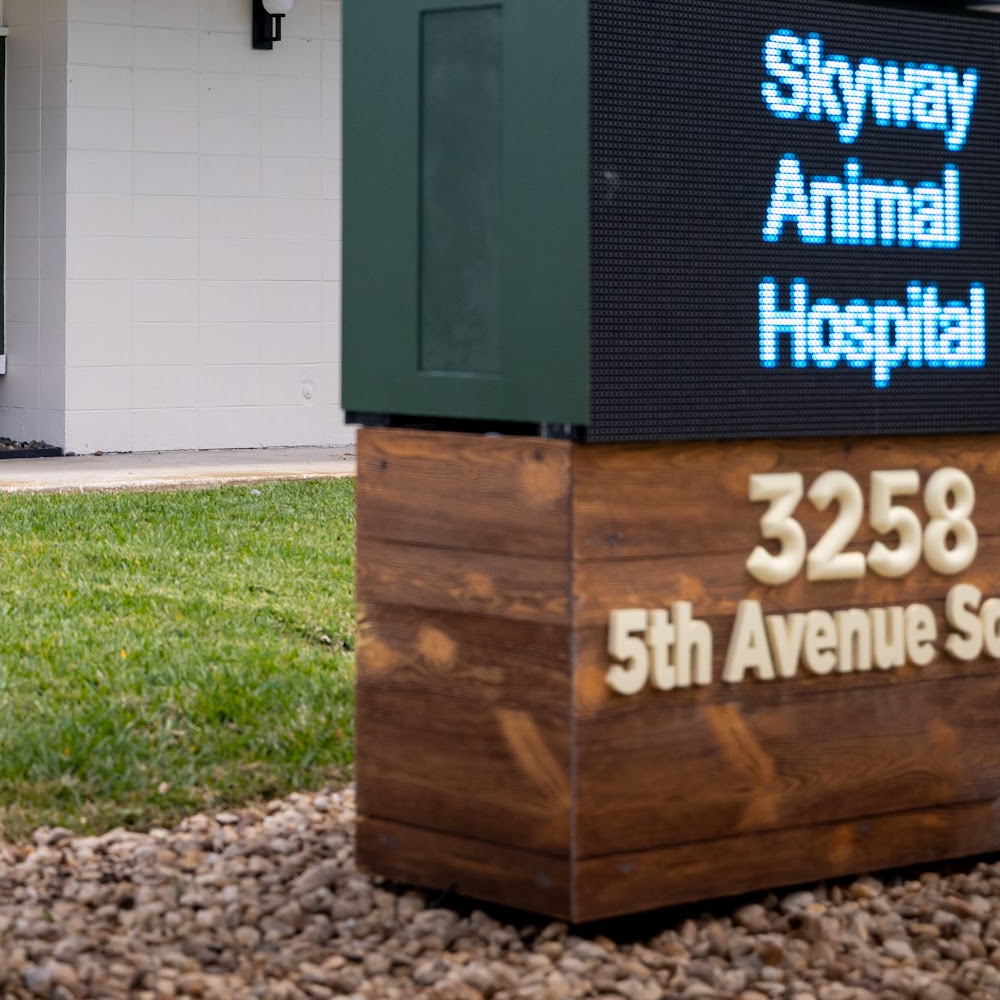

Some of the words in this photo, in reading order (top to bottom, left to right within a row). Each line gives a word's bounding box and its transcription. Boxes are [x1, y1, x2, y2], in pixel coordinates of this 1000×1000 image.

[760, 28, 980, 151] Skyway
[761, 153, 961, 249] Animal
[758, 276, 987, 388] Hospital
[745, 467, 979, 586] 3258
[605, 601, 713, 695] 5th
[721, 599, 938, 683] Avenue
